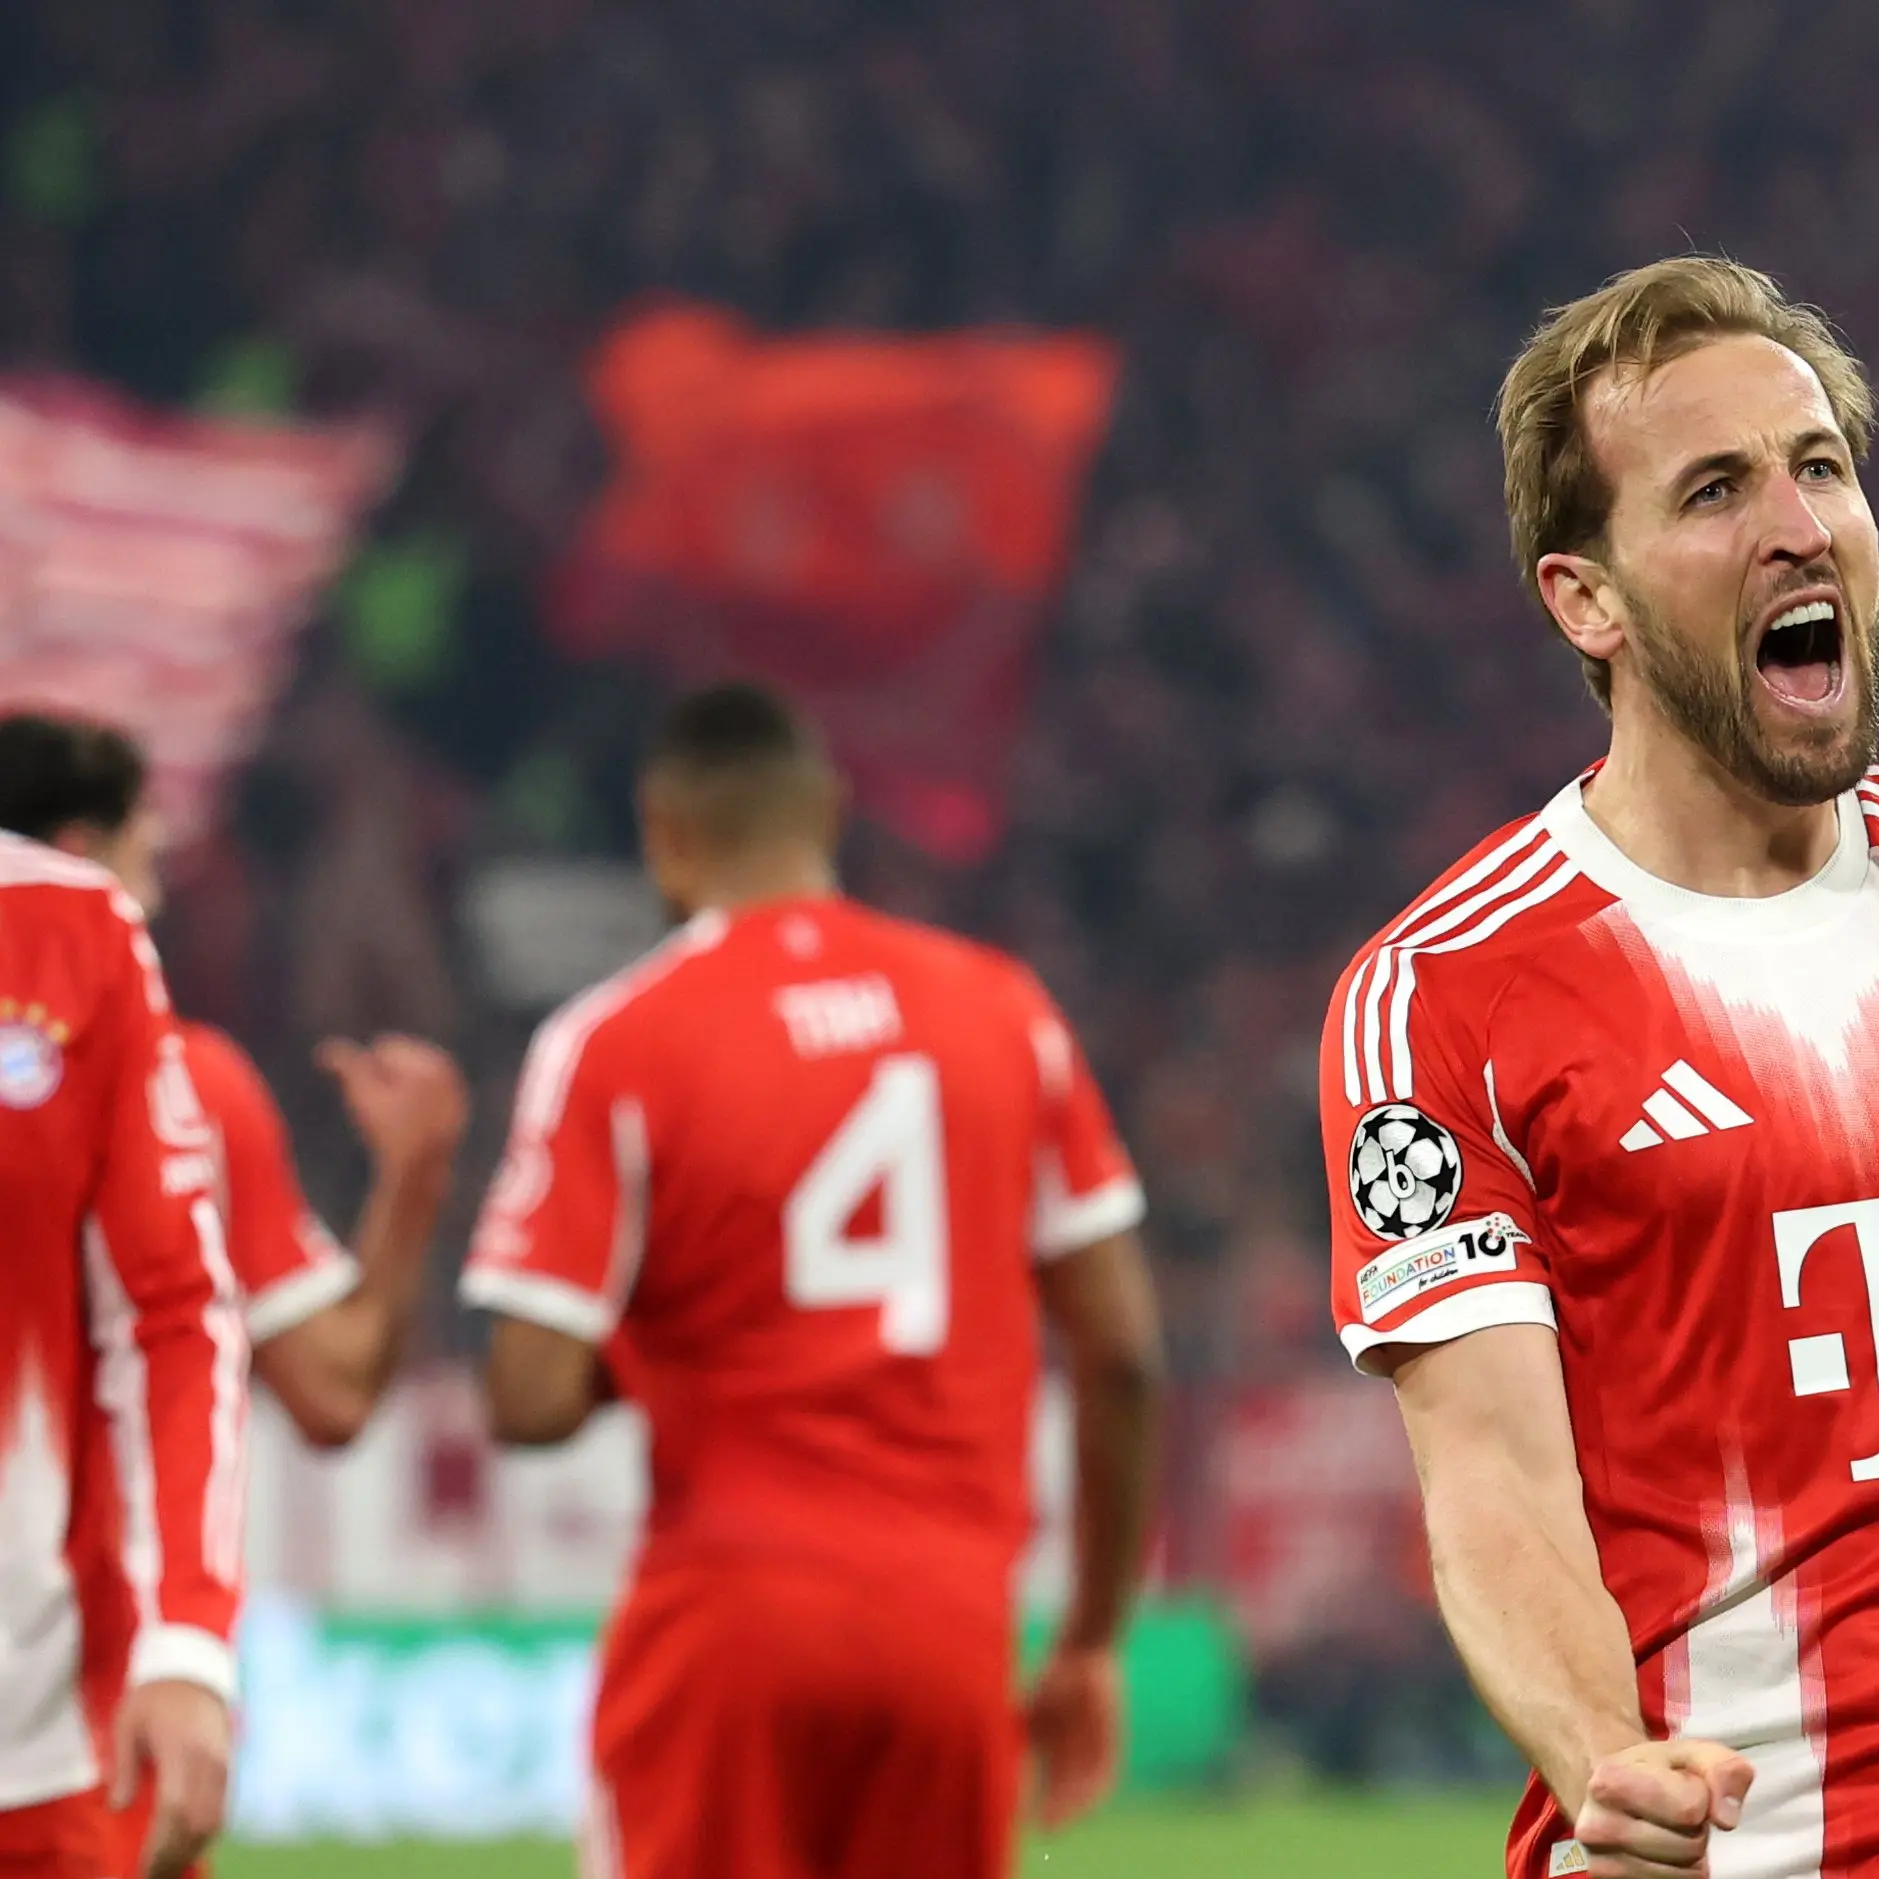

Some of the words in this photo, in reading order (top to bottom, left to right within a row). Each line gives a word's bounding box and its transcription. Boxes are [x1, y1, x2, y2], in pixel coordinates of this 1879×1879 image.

[780, 1050, 952, 1357] 4
[1458, 1229, 1506, 1260] 10
[1363, 1246, 1455, 1303] FOUNDATION
